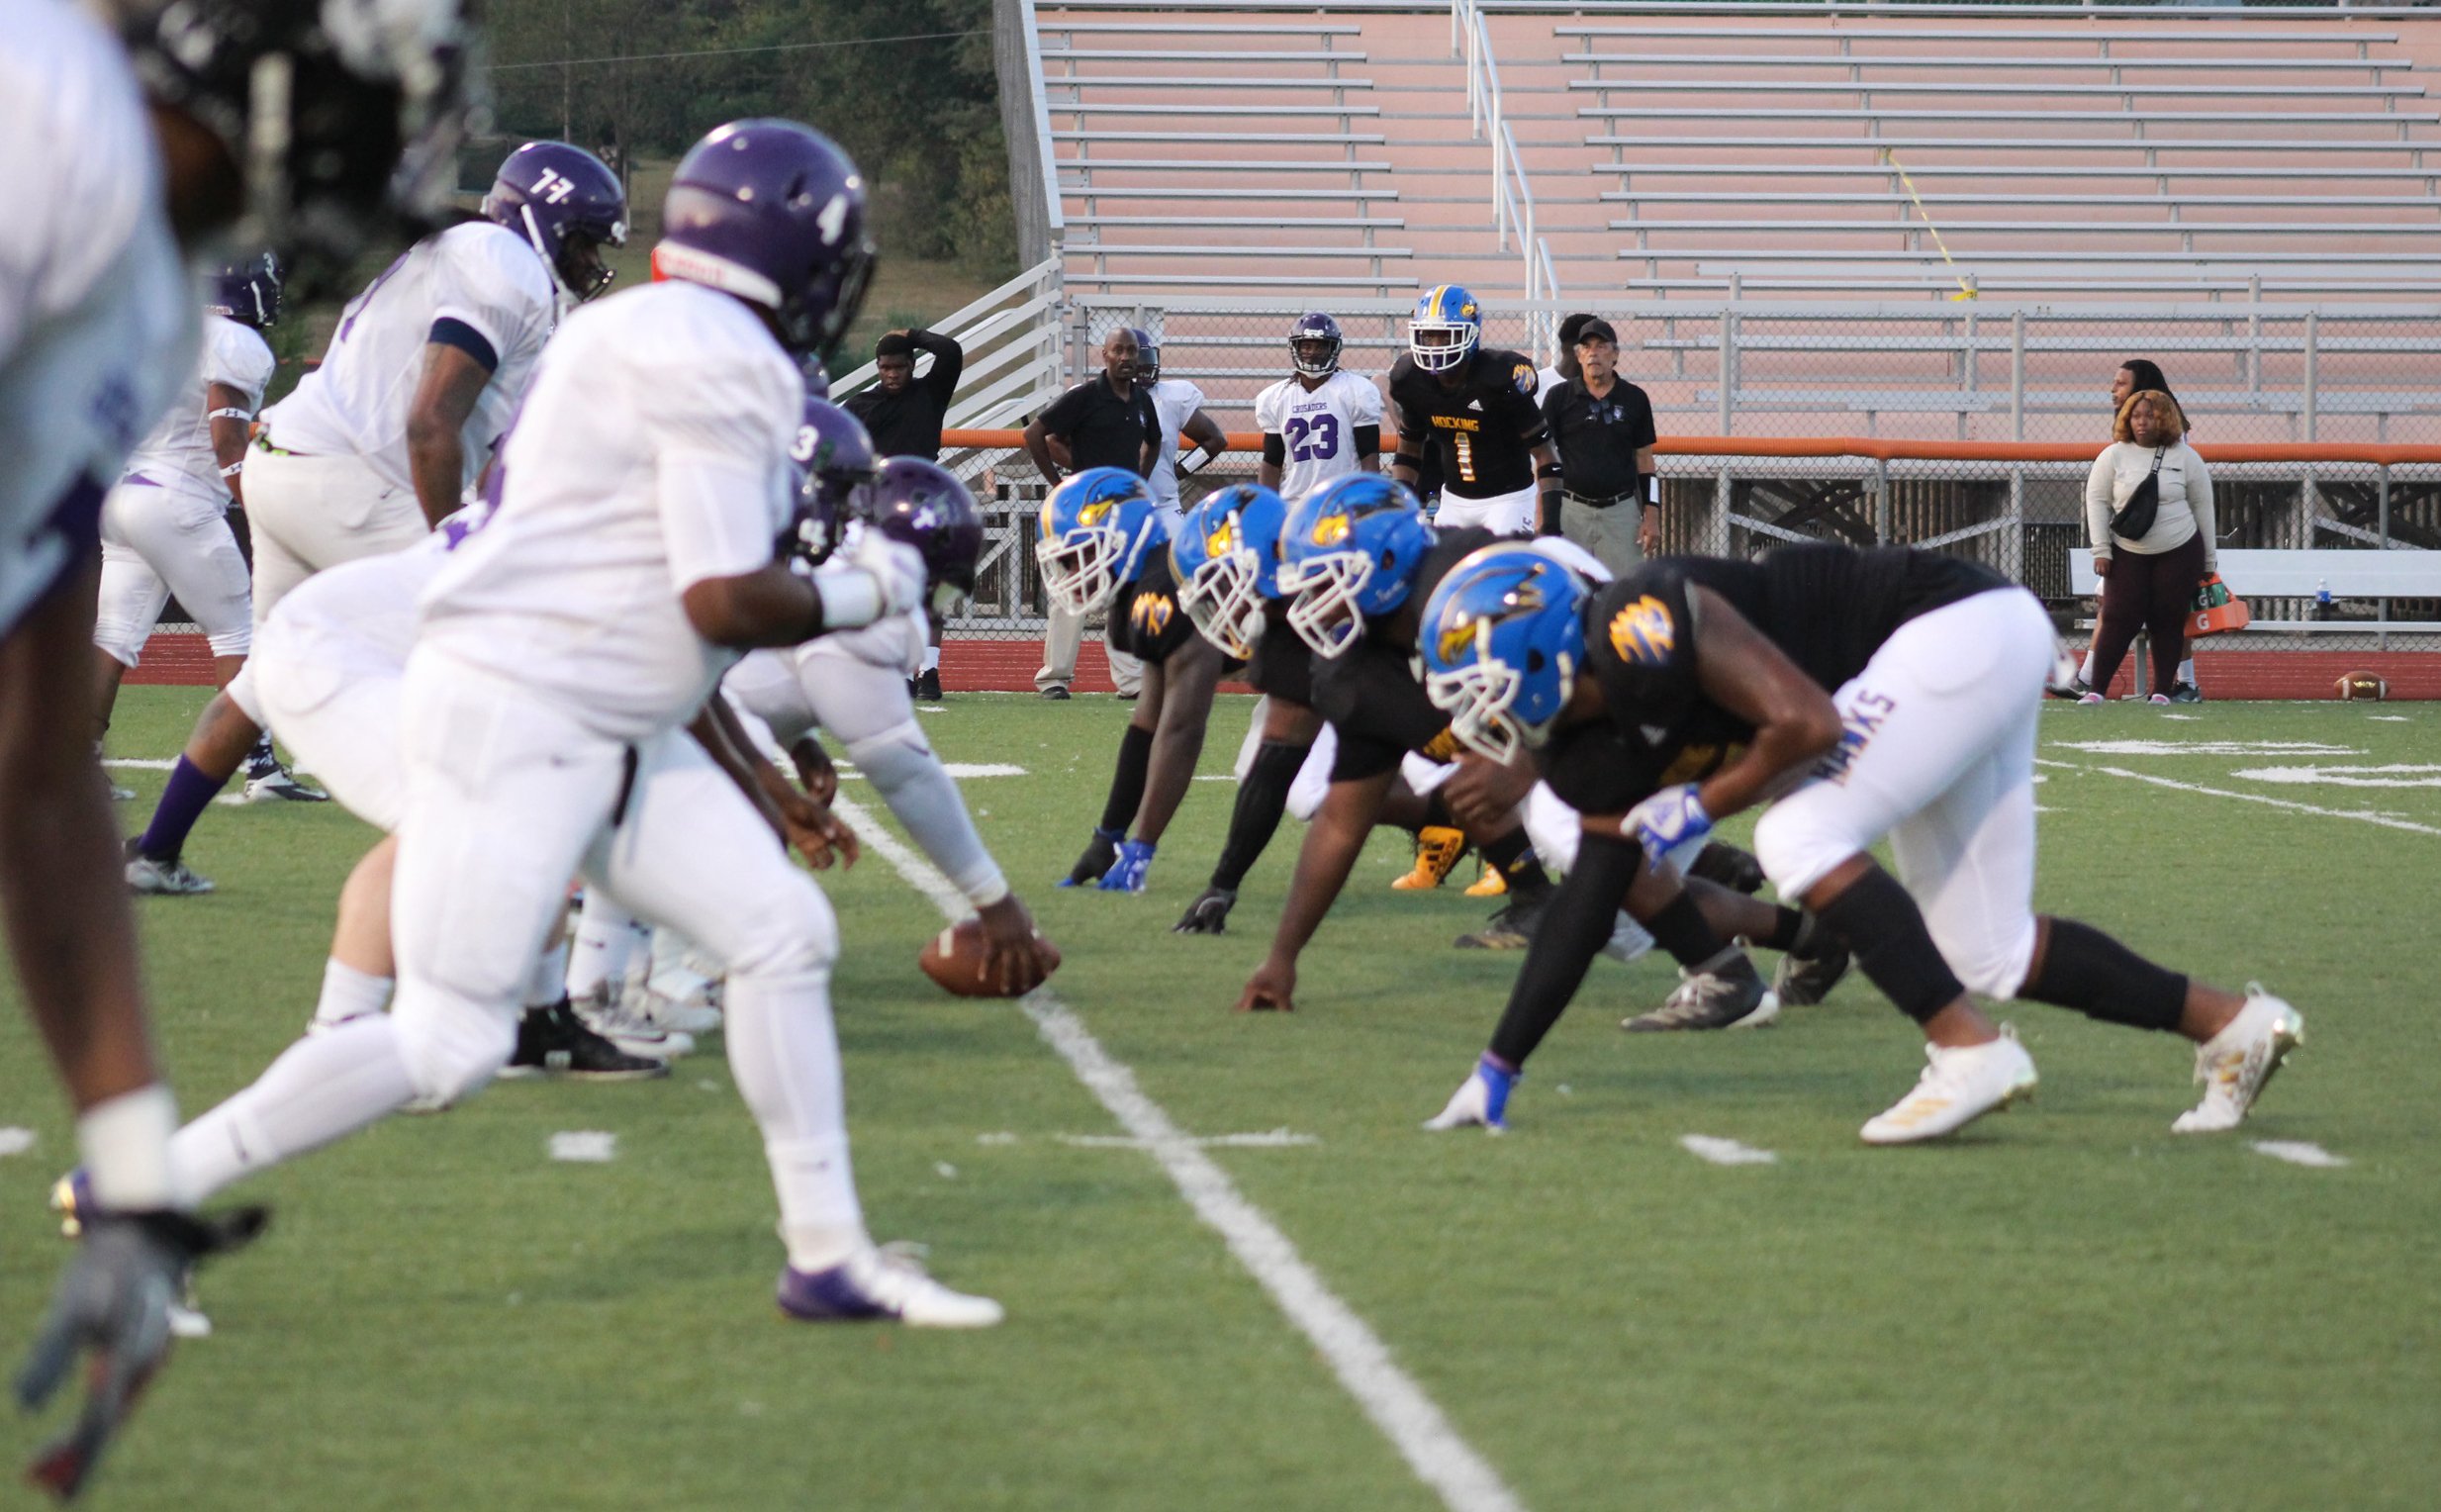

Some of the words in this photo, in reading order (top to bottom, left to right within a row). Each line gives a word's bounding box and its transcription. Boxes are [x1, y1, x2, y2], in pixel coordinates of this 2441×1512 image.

[530, 166, 575, 205] 77
[1292, 402, 1327, 414] CRUSADERS
[1431, 415, 1480, 431] HOCKING
[1285, 414, 1338, 462] 23
[1455, 431, 1475, 482] 1
[2197, 614, 2210, 630] G
